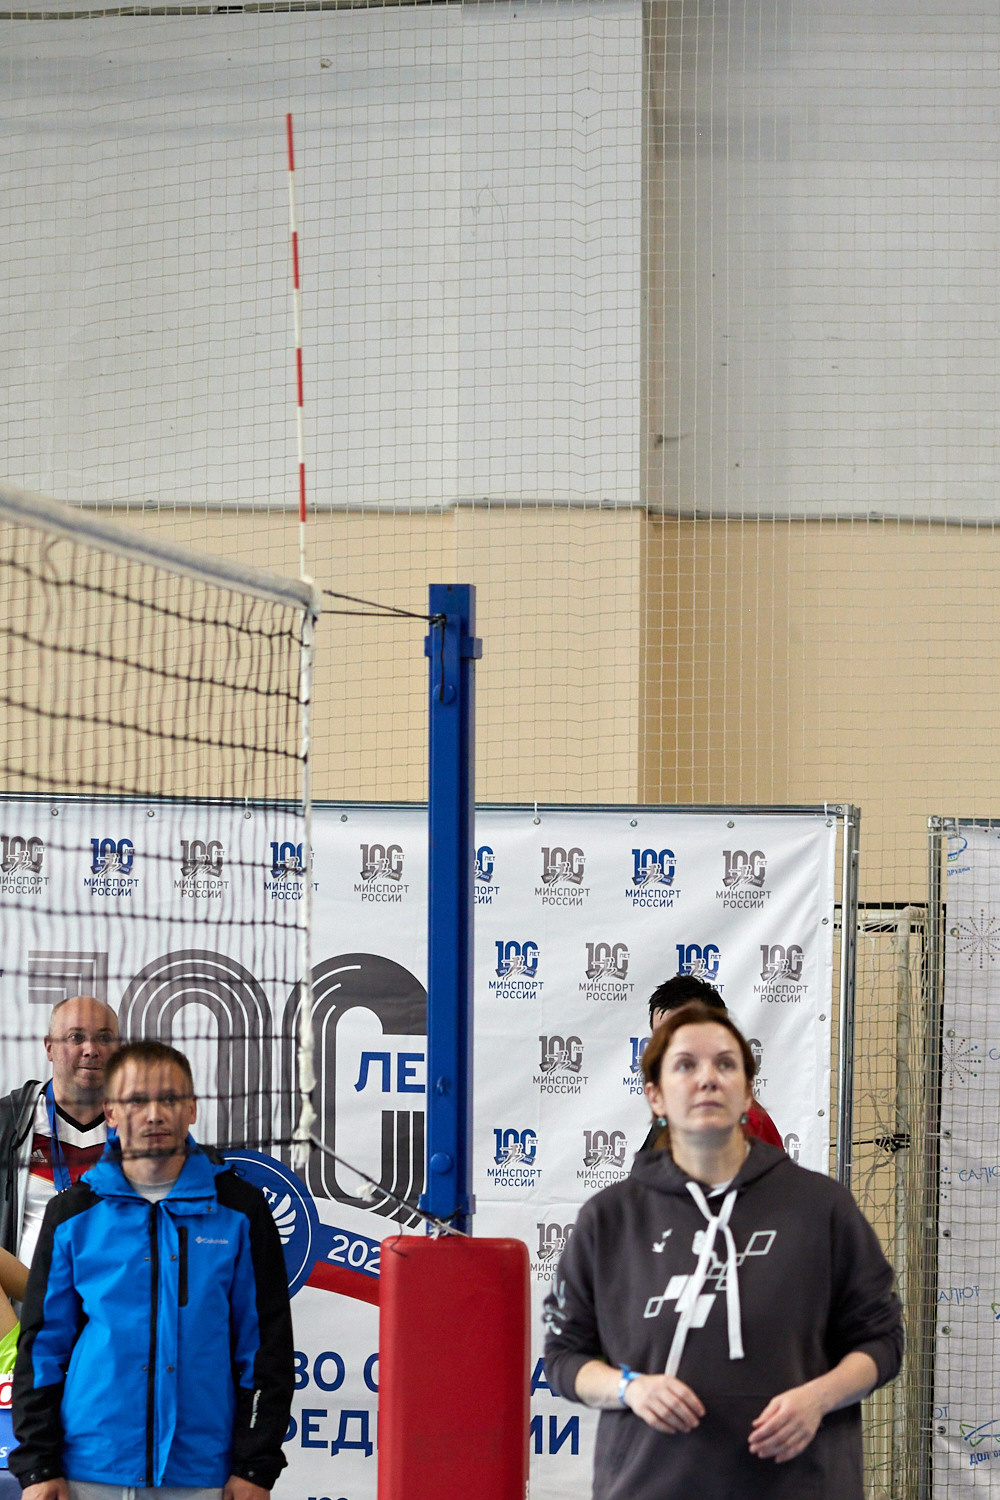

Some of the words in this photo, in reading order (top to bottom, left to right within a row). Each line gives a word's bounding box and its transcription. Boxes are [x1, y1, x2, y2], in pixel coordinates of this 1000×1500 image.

[1, 836, 43, 866] 100
[91, 838, 133, 866] 100
[181, 840, 223, 866] 100
[360, 844, 402, 871] 100
[541, 847, 584, 874] 100
[632, 849, 675, 876] 100
[723, 850, 765, 877] 100
[0, 877, 49, 885] ИНСПОРТ
[84, 878, 139, 887] МИНСПОРТ
[174, 880, 229, 889] МИНСПОРТ
[2, 886, 41, 894] РОССИИ
[91, 888, 131, 896] РОССИИ
[354, 884, 409, 893] МИНСПОРТ
[534, 888, 590, 896] МИНСПОРТ
[182, 890, 221, 898] РОССИИ
[362, 894, 401, 902] РОССИИ
[625, 890, 681, 898] МИНСПОРТ
[716, 891, 772, 899] МИНСПОРТ
[542, 897, 583, 906] РОССИИ
[633, 899, 673, 907] РОССИИ
[723, 900, 764, 908] РОССИИ
[495, 941, 538, 969] 100
[586, 943, 628, 971] 100
[676, 944, 719, 971] 100
[760, 945, 802, 973] 100
[489, 981, 544, 990] МИНСПОРТ
[579, 983, 634, 992] МИНСПОРТ
[754, 985, 808, 994] МИНСПОРТ
[496, 991, 536, 999] РОССИИ
[587, 993, 627, 1001] РОССИИ
[761, 995, 800, 1003] РОССИИ
[539, 1036, 582, 1064] 100
[354, 1051, 425, 1093] ЛЕ
[533, 1076, 588, 1085] МИНСПОРТ
[540, 1086, 581, 1094] РОССИИ
[494, 1129, 536, 1157] 100
[583, 1131, 626, 1158] 100
[487, 1169, 542, 1178] МИНСПОРТ
[577, 1170, 631, 1179] МИНСПОРТ
[494, 1178, 534, 1186] РОССИИ
[327, 1234, 380, 1275] 202
[938, 1285, 979, 1304] АЛЮТ
